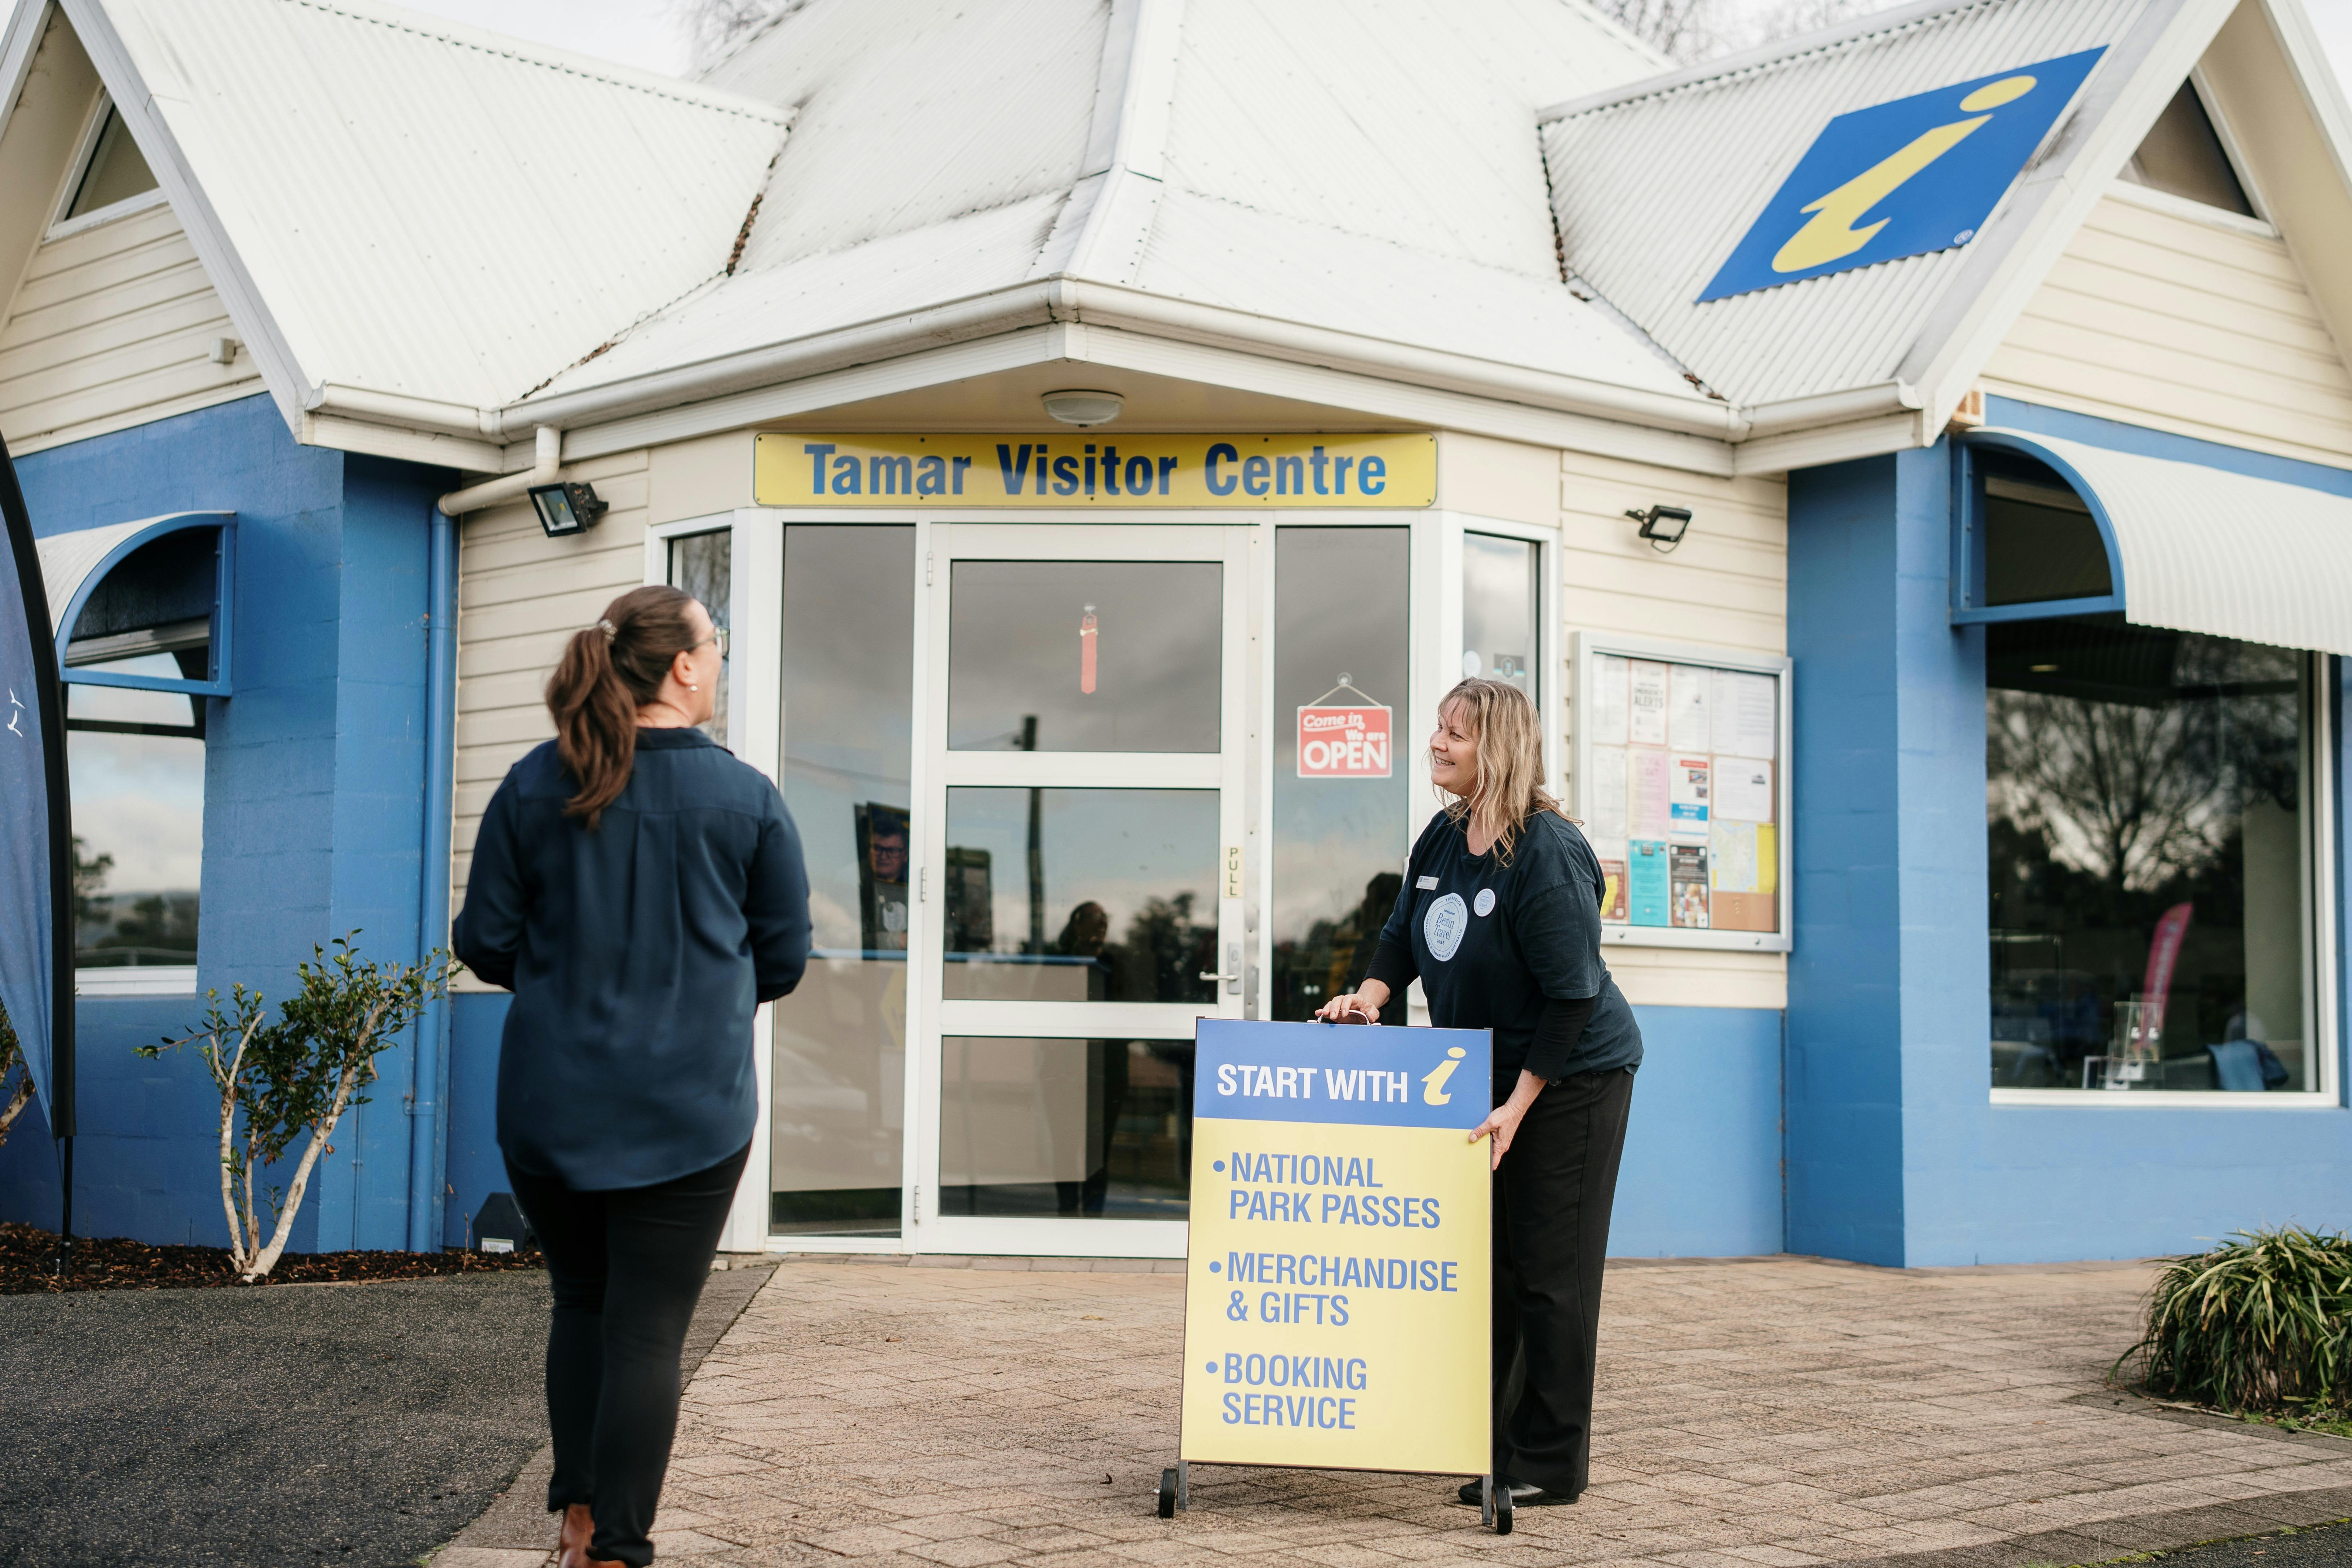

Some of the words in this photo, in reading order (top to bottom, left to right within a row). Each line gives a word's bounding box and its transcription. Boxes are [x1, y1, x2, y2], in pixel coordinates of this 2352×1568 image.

[805, 444, 971, 495] Tamar
[997, 445, 1177, 495] Visitor
[1205, 443, 1386, 496] Centre
[1634, 695, 1664, 708] ALERTS
[1303, 714, 1346, 728] Come
[1345, 729, 1364, 741] We
[1366, 730, 1386, 741] are
[1303, 740, 1388, 770] OPEN
[1229, 847, 1239, 896] PULL
[1451, 896, 1462, 907] REGION
[1433, 924, 1451, 941] Travel
[1436, 913, 1448, 927] Best
[1447, 917, 1454, 929] in
[1432, 948, 1441, 957] TAMAR
[1451, 929, 1463, 953] AUSTRALIA
[1217, 1064, 1317, 1099] START
[1325, 1069, 1407, 1103] WITH
[1231, 1152, 1383, 1188] NATIONAL
[1230, 1189, 1312, 1223] PARK
[1322, 1194, 1440, 1229] PASSES
[1228, 1251, 1458, 1292] MERCHANDISE
[1226, 1290, 1248, 1321] &
[1260, 1291, 1349, 1326] GIFTS
[1224, 1353, 1366, 1390] BOOKING
[1223, 1392, 1356, 1429] SERVICE
